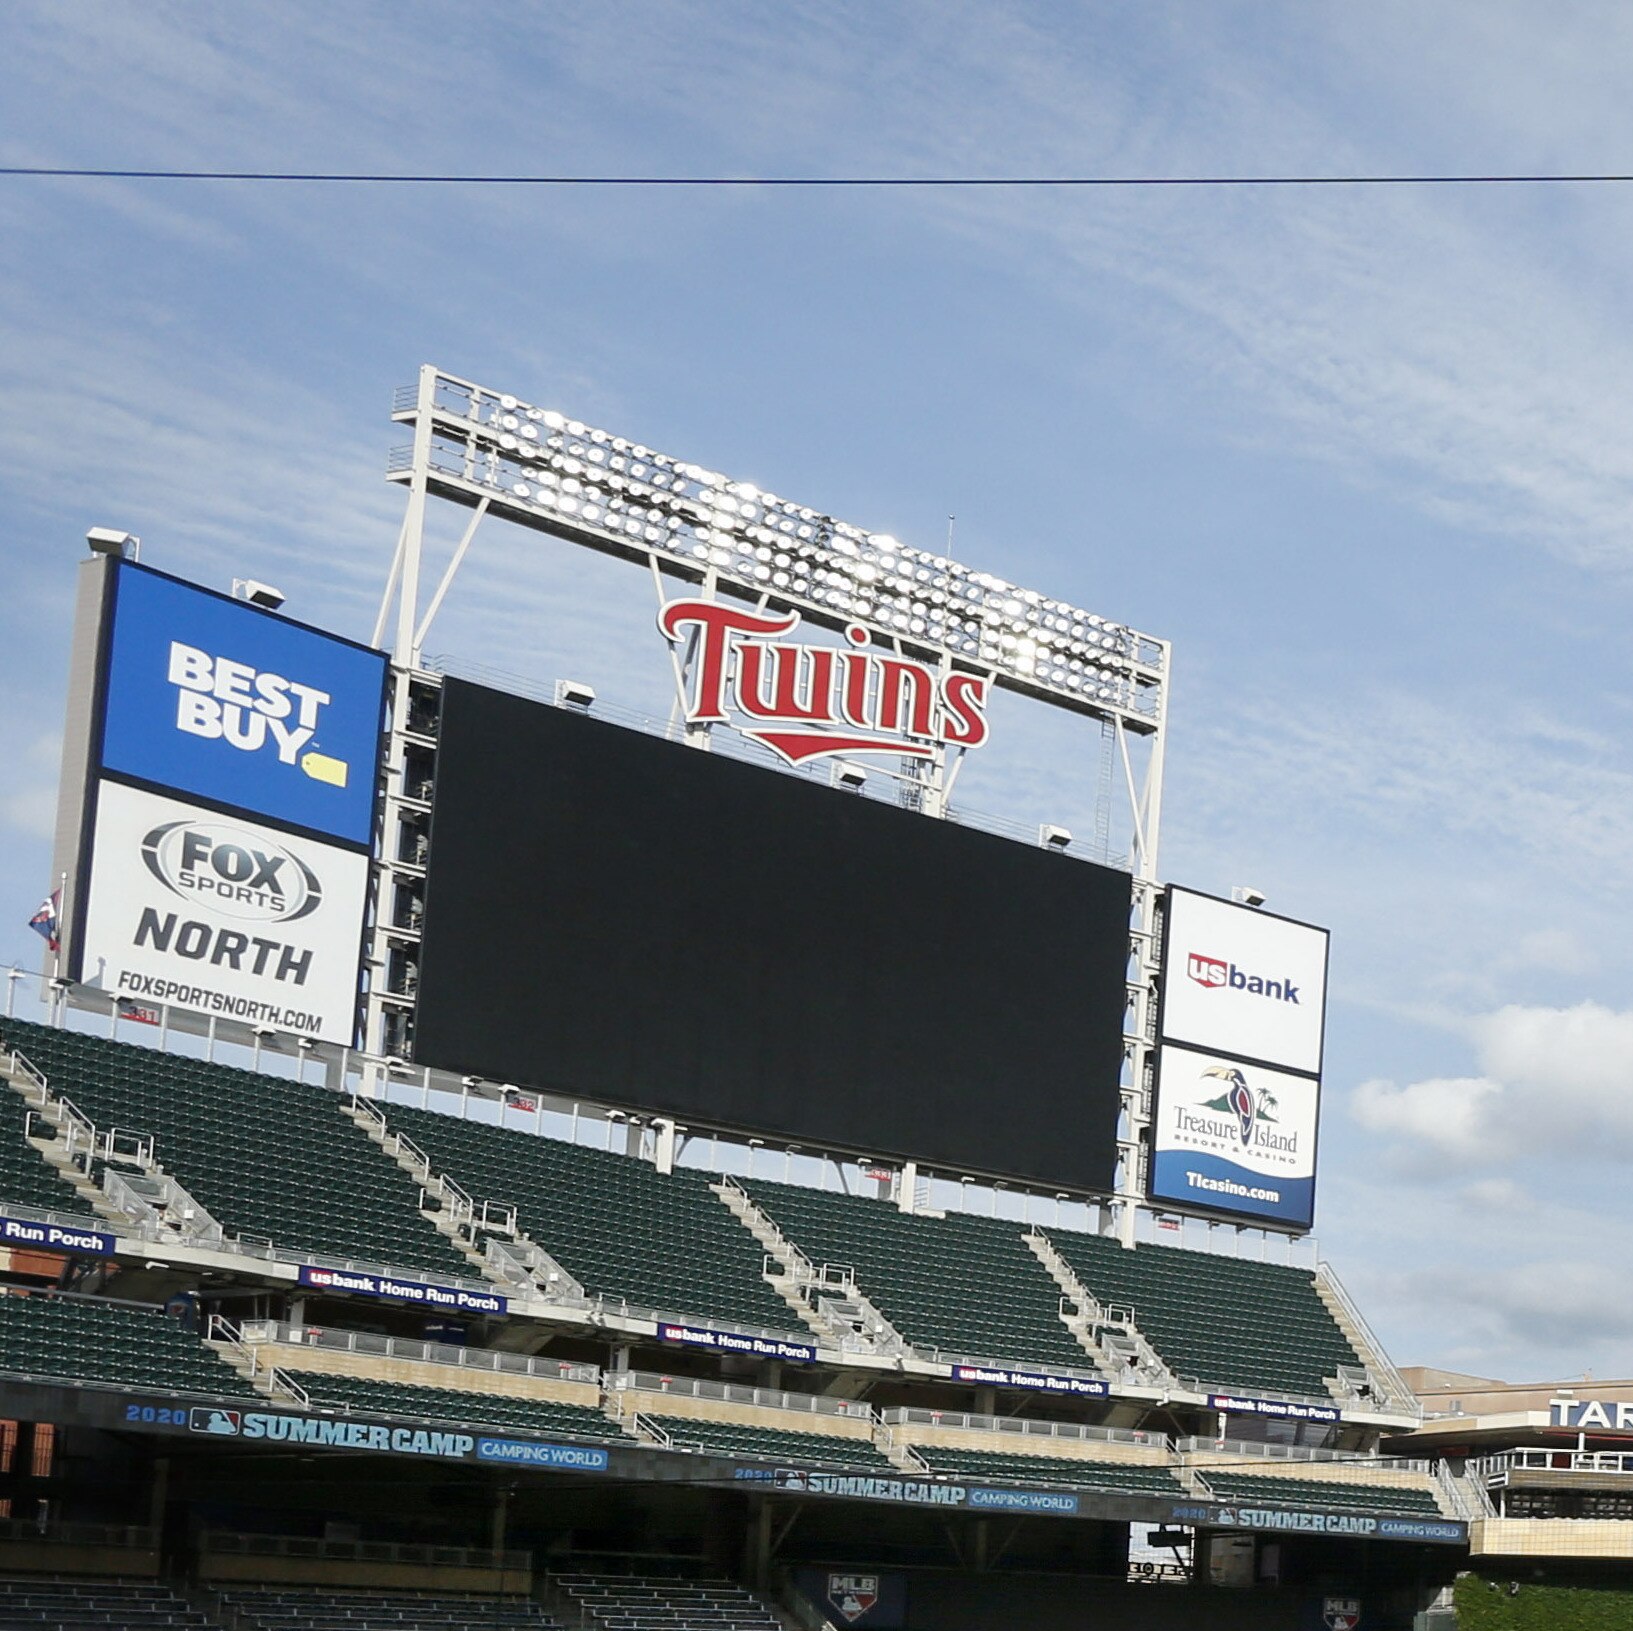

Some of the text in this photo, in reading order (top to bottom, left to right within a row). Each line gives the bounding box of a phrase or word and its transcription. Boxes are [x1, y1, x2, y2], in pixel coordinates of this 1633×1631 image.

[168, 641, 330, 729] BEST
[658, 598, 988, 750] Twins
[177, 688, 313, 765] BUY
[181, 832, 285, 895] FOX
[179, 872, 285, 912] SPORTS
[134, 907, 313, 985] NORTH
[118, 970, 322, 1033] FOXSPORTSNORTH.COM
[1174, 1106, 1298, 1153] Treasure Island
[1174, 1134, 1226, 1150] RESORT
[1247, 1149, 1297, 1164] CASINO
[1186, 1171, 1280, 1203] TIcasino.com
[6, 1223, 104, 1251] Run Porch
[379, 1281, 423, 1299] Home
[426, 1288, 455, 1303] Run
[457, 1295, 499, 1311] Porch
[718, 1334, 752, 1350] Home
[754, 1339, 776, 1353] Run
[778, 1344, 810, 1360] Porch
[1011, 1373, 1044, 1388] Home
[1047, 1377, 1069, 1390] Run
[1070, 1380, 1102, 1394] Porch
[1257, 1402, 1287, 1415] Home
[1287, 1405, 1307, 1417] Run
[1308, 1408, 1336, 1420] Porch
[126, 1404, 604, 1467] 2020 SUMMER CAMP CAMPING WORLD
[807, 1473, 902, 1500] SUMMER
[902, 1483, 966, 1505] CAMP
[972, 1491, 1028, 1507] CAMPING
[1029, 1495, 1074, 1509] WORLD
[1238, 1509, 1326, 1531] SUMMER
[1326, 1515, 1376, 1535] CAMP
[1381, 1522, 1425, 1537] CAMPING
[1425, 1525, 1460, 1538] WORLD
[832, 1577, 876, 1592] MLB
[1326, 1600, 1358, 1612] MLB
